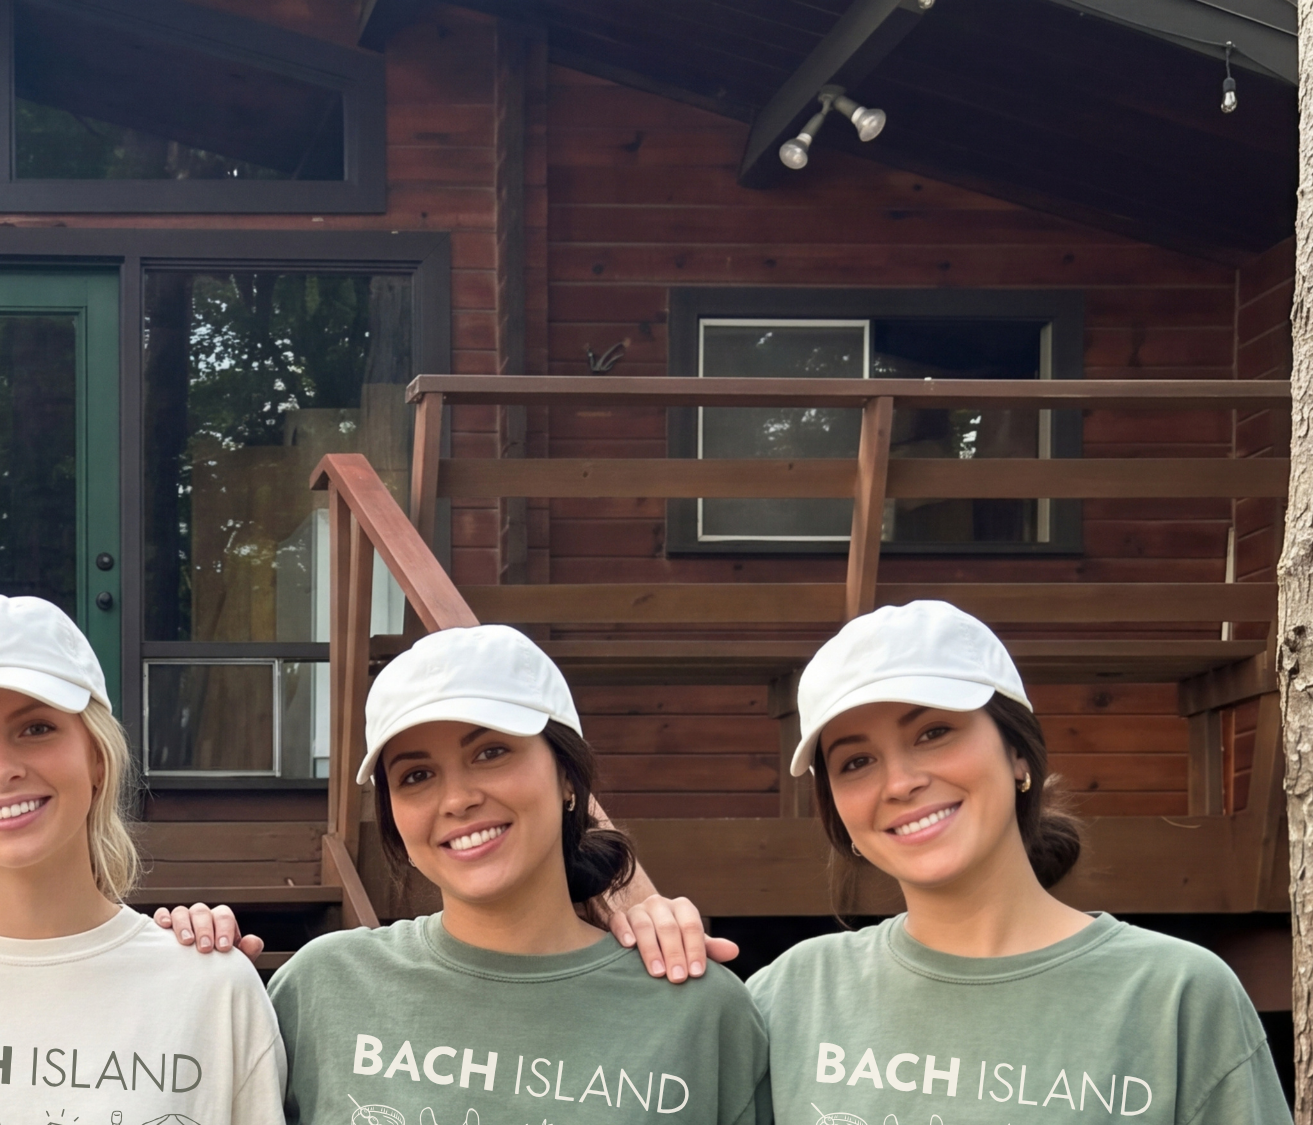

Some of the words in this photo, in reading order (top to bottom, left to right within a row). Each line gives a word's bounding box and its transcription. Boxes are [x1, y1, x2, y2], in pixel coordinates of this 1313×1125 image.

[31, 1046, 202, 1093] ISLAND
[352, 1033, 499, 1091] BACH
[514, 1055, 689, 1114] ISLAND
[816, 1042, 960, 1097] BACH
[977, 1060, 1152, 1116] ISLAND
